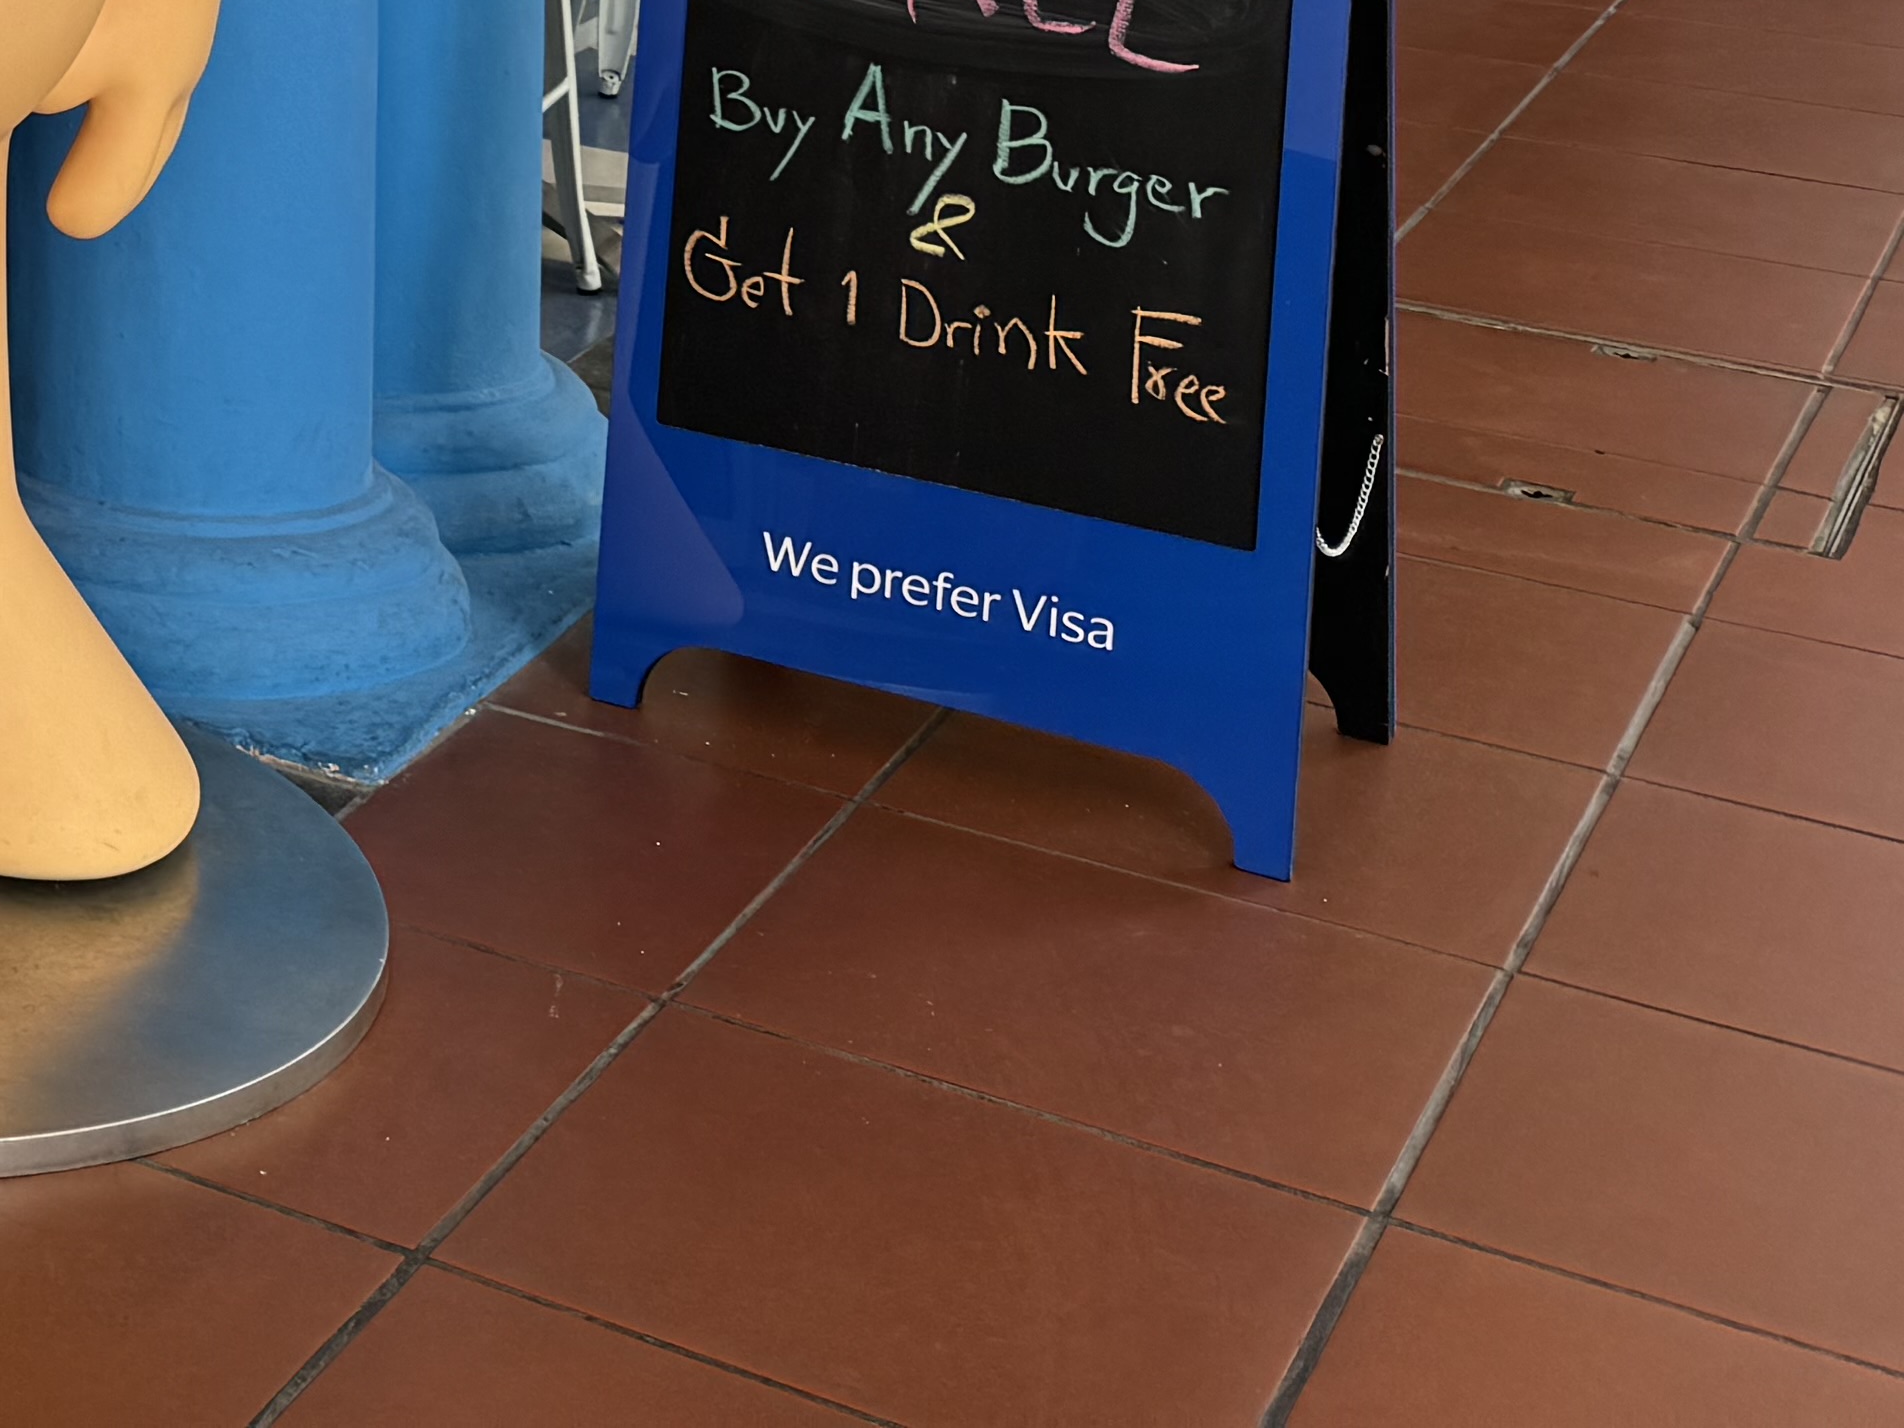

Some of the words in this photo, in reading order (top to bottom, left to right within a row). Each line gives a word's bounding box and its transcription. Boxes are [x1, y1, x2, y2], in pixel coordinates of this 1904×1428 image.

[710, 67, 815, 182] Buy
[841, 64, 967, 216] Any
[993, 99, 1230, 247] Burger
[683, 216, 804, 316] Get
[841, 270, 857, 325] 1
[899, 278, 1087, 374] Drink
[1130, 306, 1226, 424] Free
[763, 531, 838, 585] We
[849, 558, 1002, 624] prefer
[1011, 588, 1116, 651] Visa
